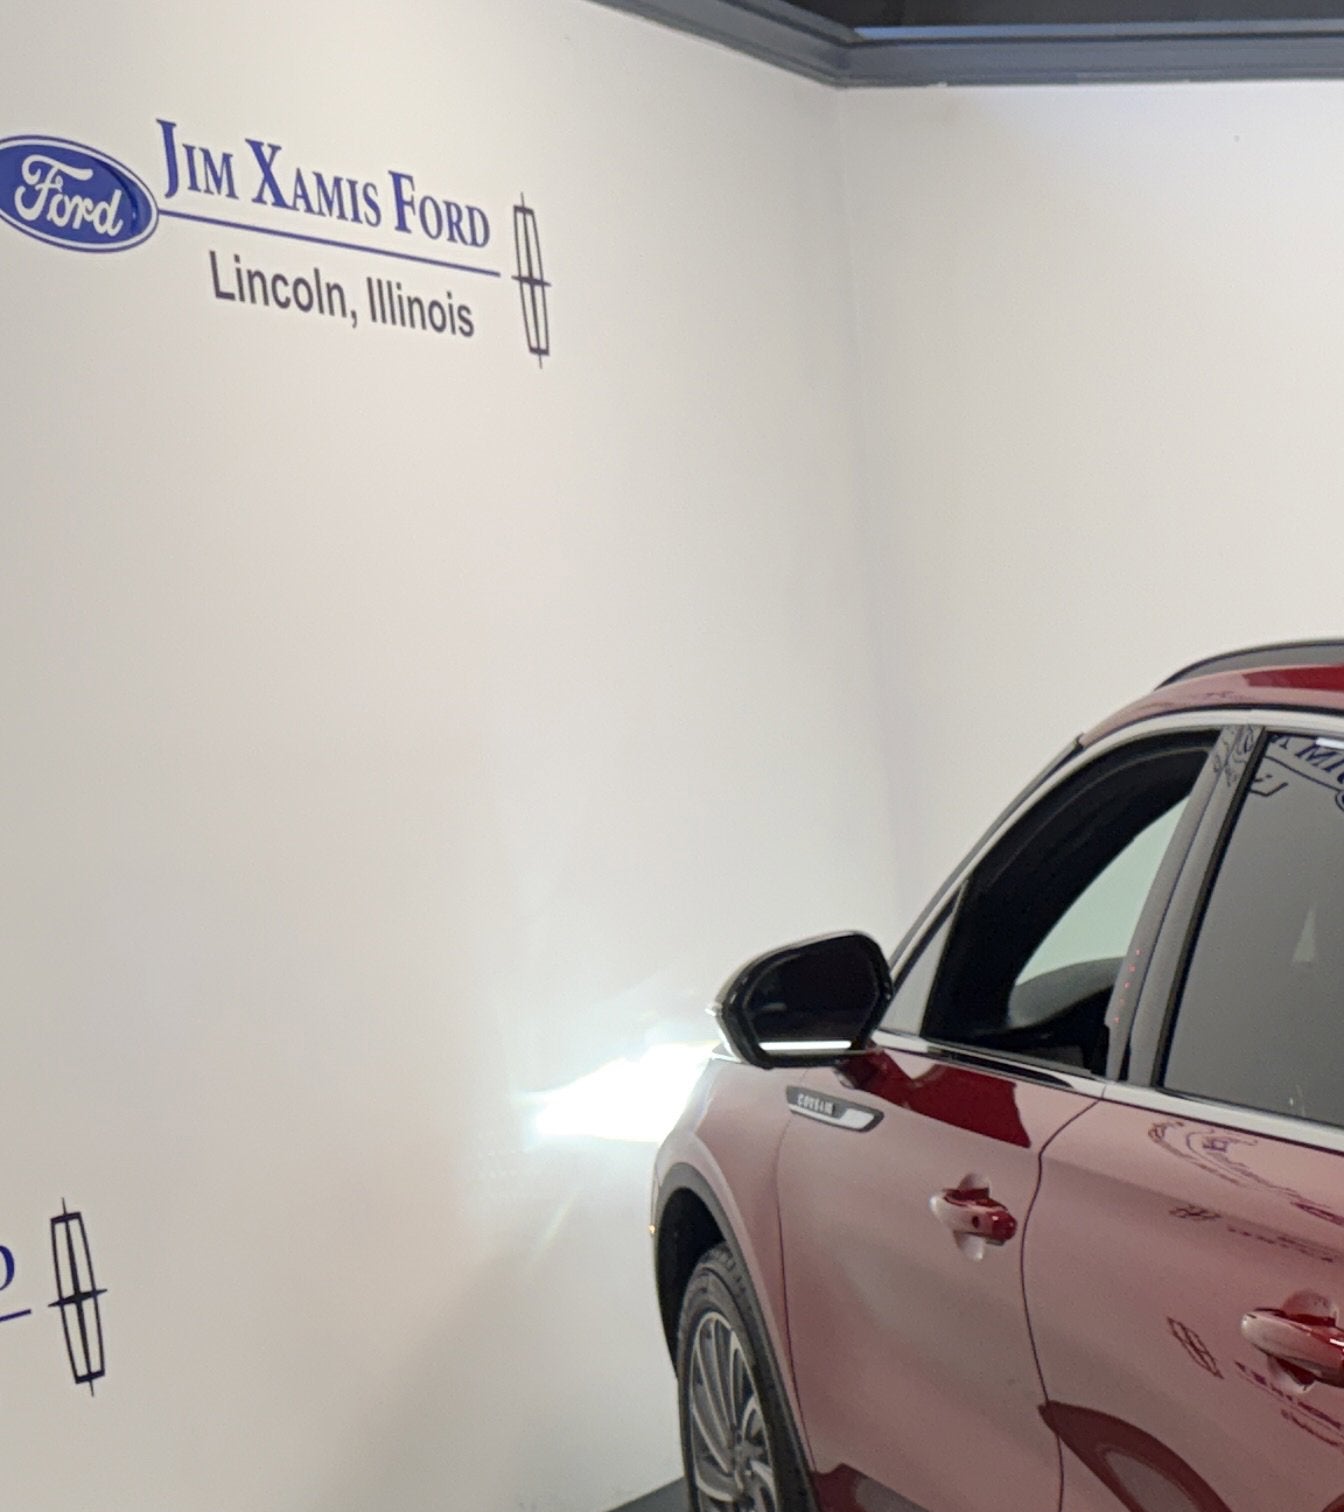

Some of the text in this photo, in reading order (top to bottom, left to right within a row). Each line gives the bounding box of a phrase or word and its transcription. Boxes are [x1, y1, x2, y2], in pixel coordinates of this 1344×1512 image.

[14, 153, 125, 238] Ford
[156, 119, 490, 249] JIM XAMIS FORD
[208, 250, 475, 337] Lincoln, Illinois
